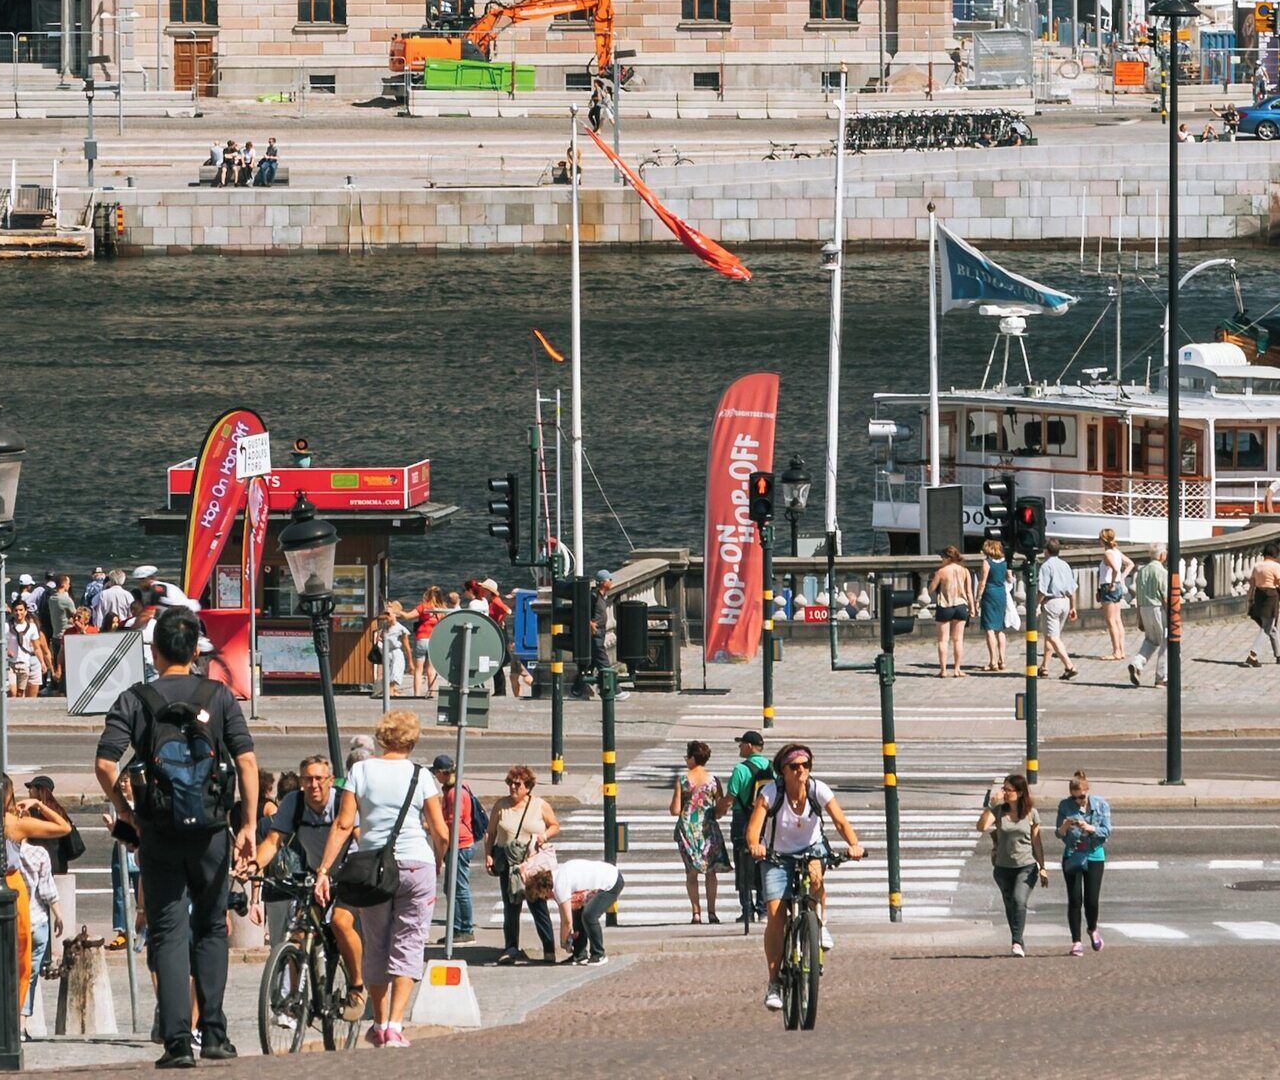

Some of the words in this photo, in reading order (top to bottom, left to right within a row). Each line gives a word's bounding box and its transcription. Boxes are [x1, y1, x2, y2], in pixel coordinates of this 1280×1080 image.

[200, 499, 220, 528] Hop
[211, 477, 229, 498] On
[728, 432, 760, 543] HOP-OFF
[717, 523, 745, 626] HOP-ON
